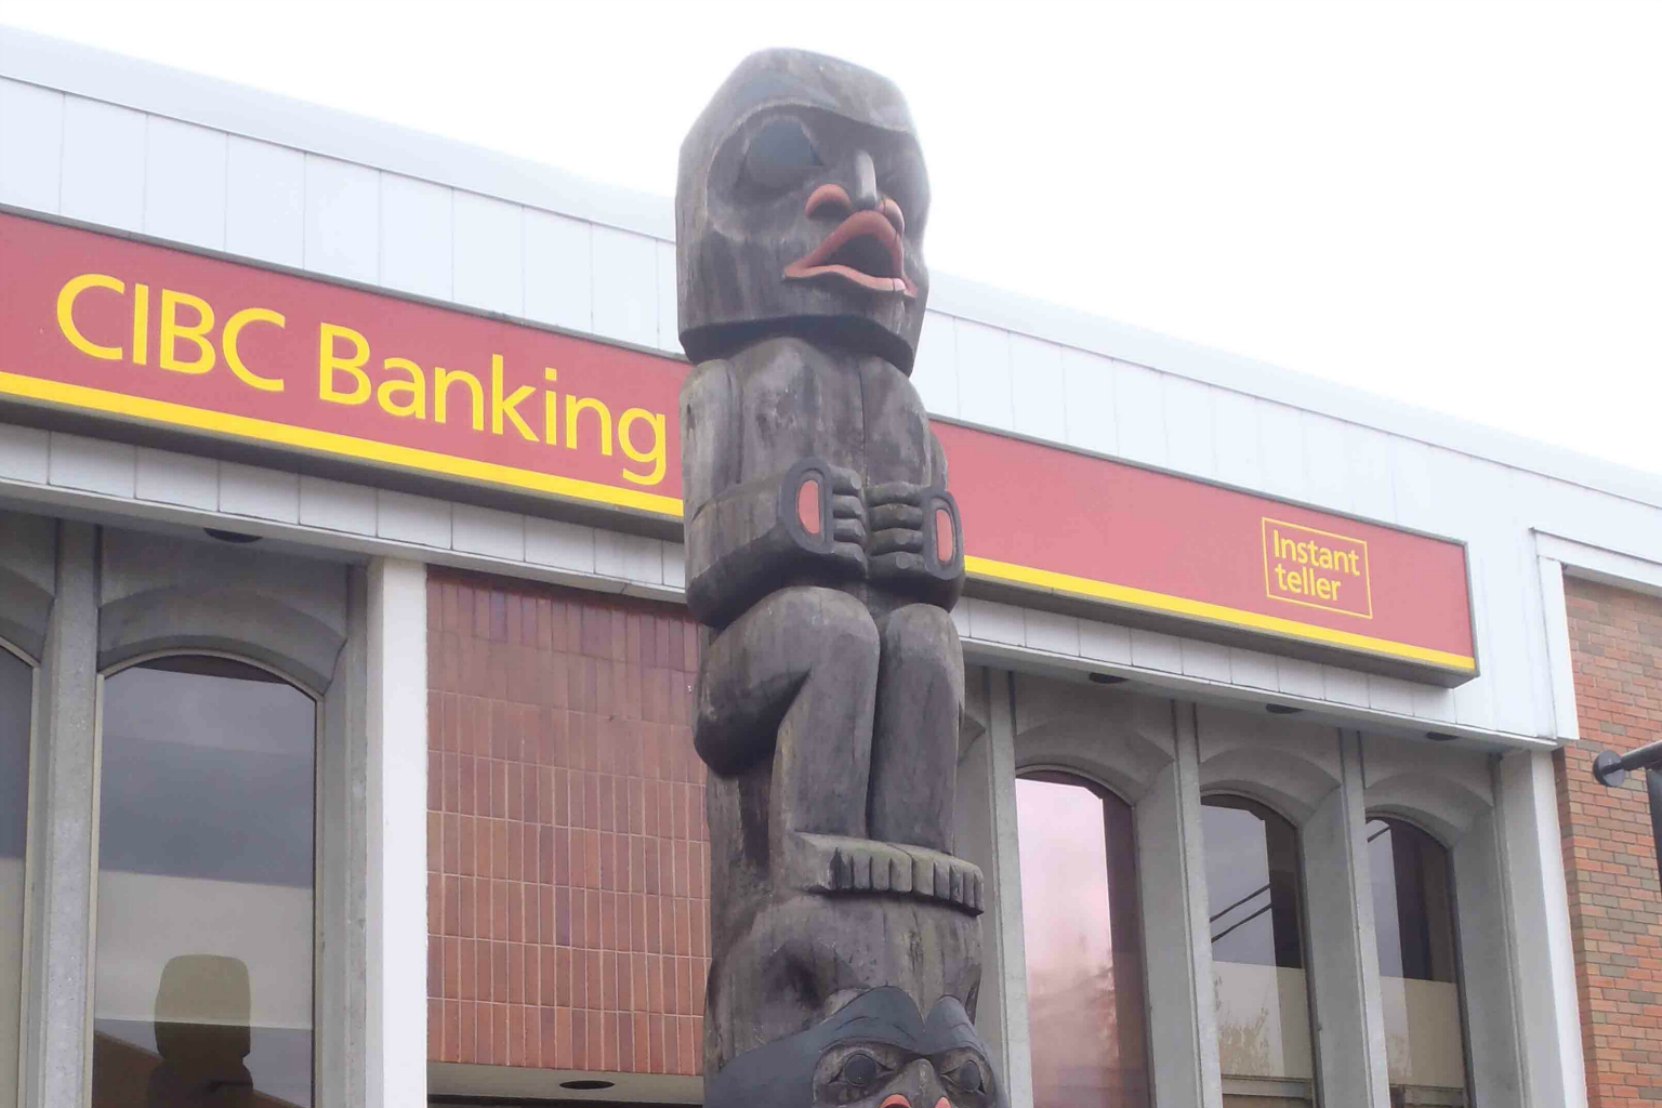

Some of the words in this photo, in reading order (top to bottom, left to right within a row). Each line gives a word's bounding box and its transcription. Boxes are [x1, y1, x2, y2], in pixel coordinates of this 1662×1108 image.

[57, 273, 286, 392] CIBC
[319, 322, 668, 486] Banking
[1273, 529, 1360, 576] Instant
[1275, 563, 1341, 601] teller
